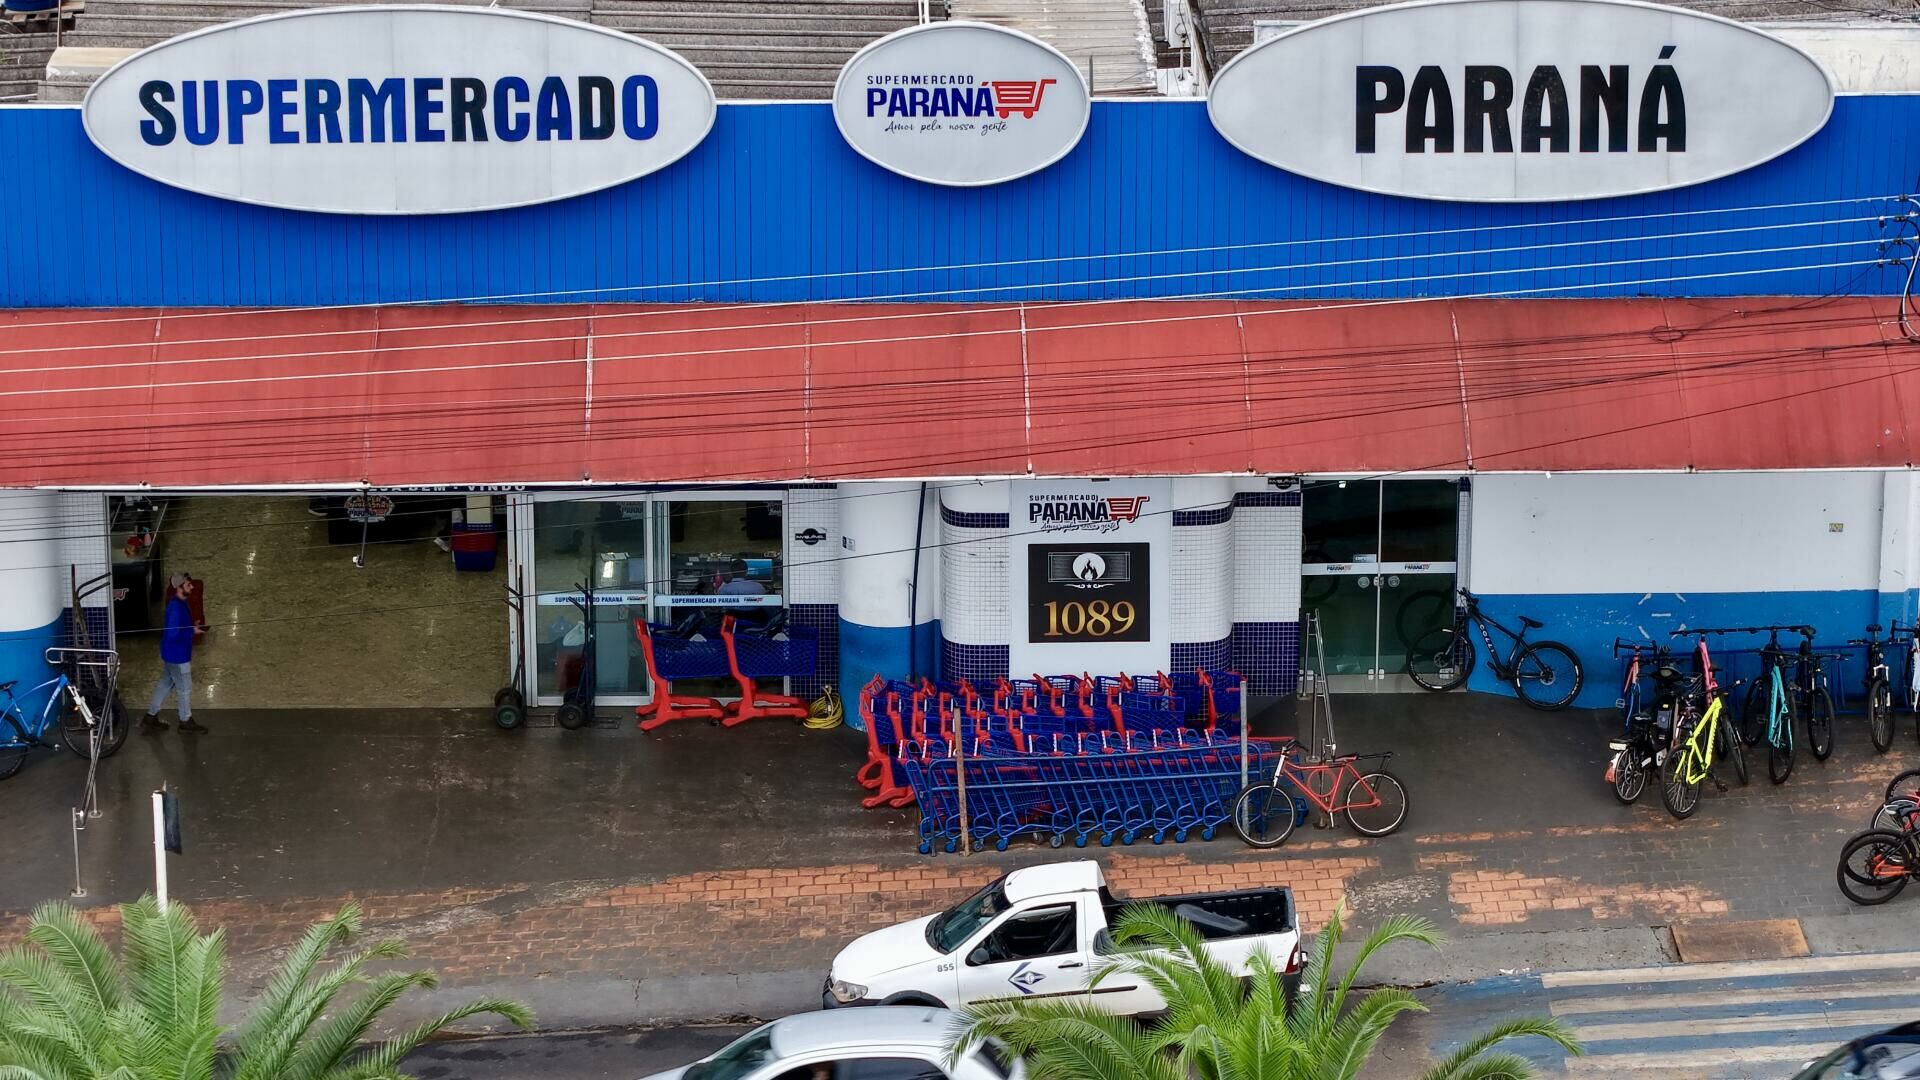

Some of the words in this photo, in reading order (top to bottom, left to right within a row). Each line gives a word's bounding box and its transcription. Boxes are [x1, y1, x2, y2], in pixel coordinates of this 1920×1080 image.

[866, 74, 975, 85] SUPERMERCADO
[138, 74, 660, 146] SUPERMERCADO
[867, 81, 996, 118] PARANÁ
[1356, 46, 1687, 154] PARANÁ
[919, 119, 942, 134] pela
[948, 121, 976, 131] nossa
[981, 119, 1008, 136] gente
[1029, 498, 1109, 522] PARANÁ
[1043, 599, 1136, 637] 1089
[937, 963, 955, 973] 855
